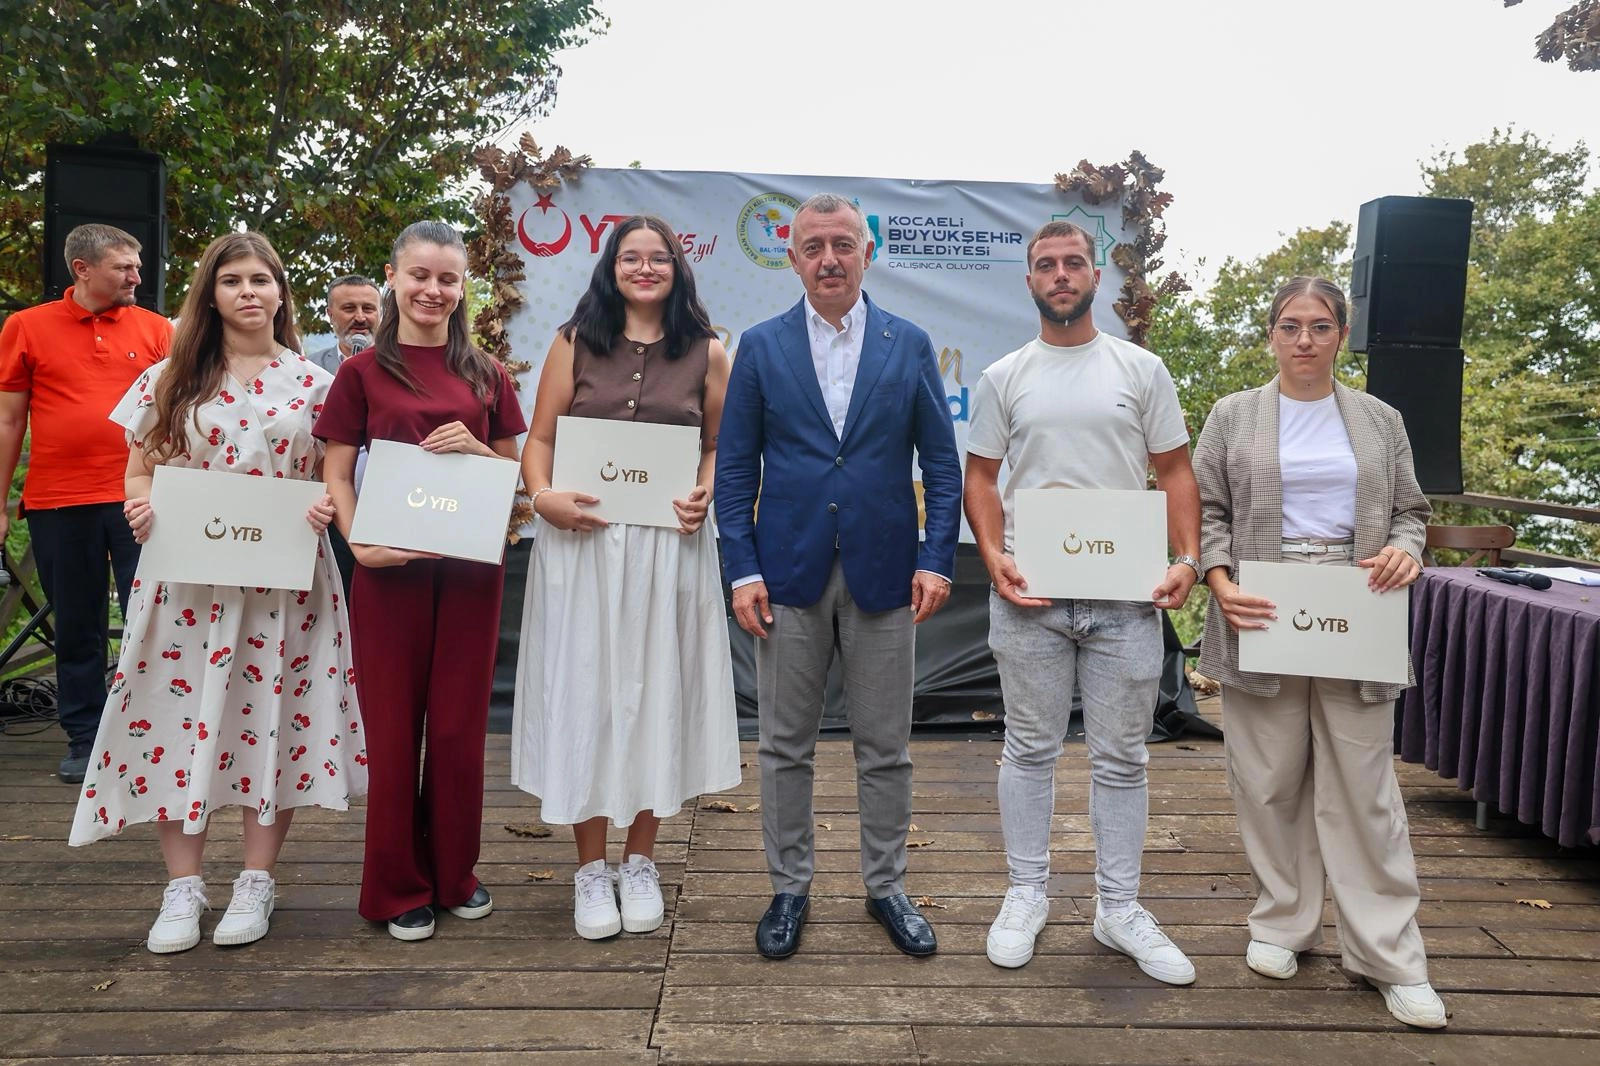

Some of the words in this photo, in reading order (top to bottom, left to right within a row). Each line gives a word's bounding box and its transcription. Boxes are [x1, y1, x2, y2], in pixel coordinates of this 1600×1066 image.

[888, 261, 943, 270] ÇALIŞINCA
[946, 263, 990, 271] OLUYOR
[621, 468, 649, 484] YTB
[430, 495, 458, 512] YTB
[231, 525, 263, 542] YTB
[1085, 540, 1115, 555] YTB
[1316, 617, 1349, 633] YTB
